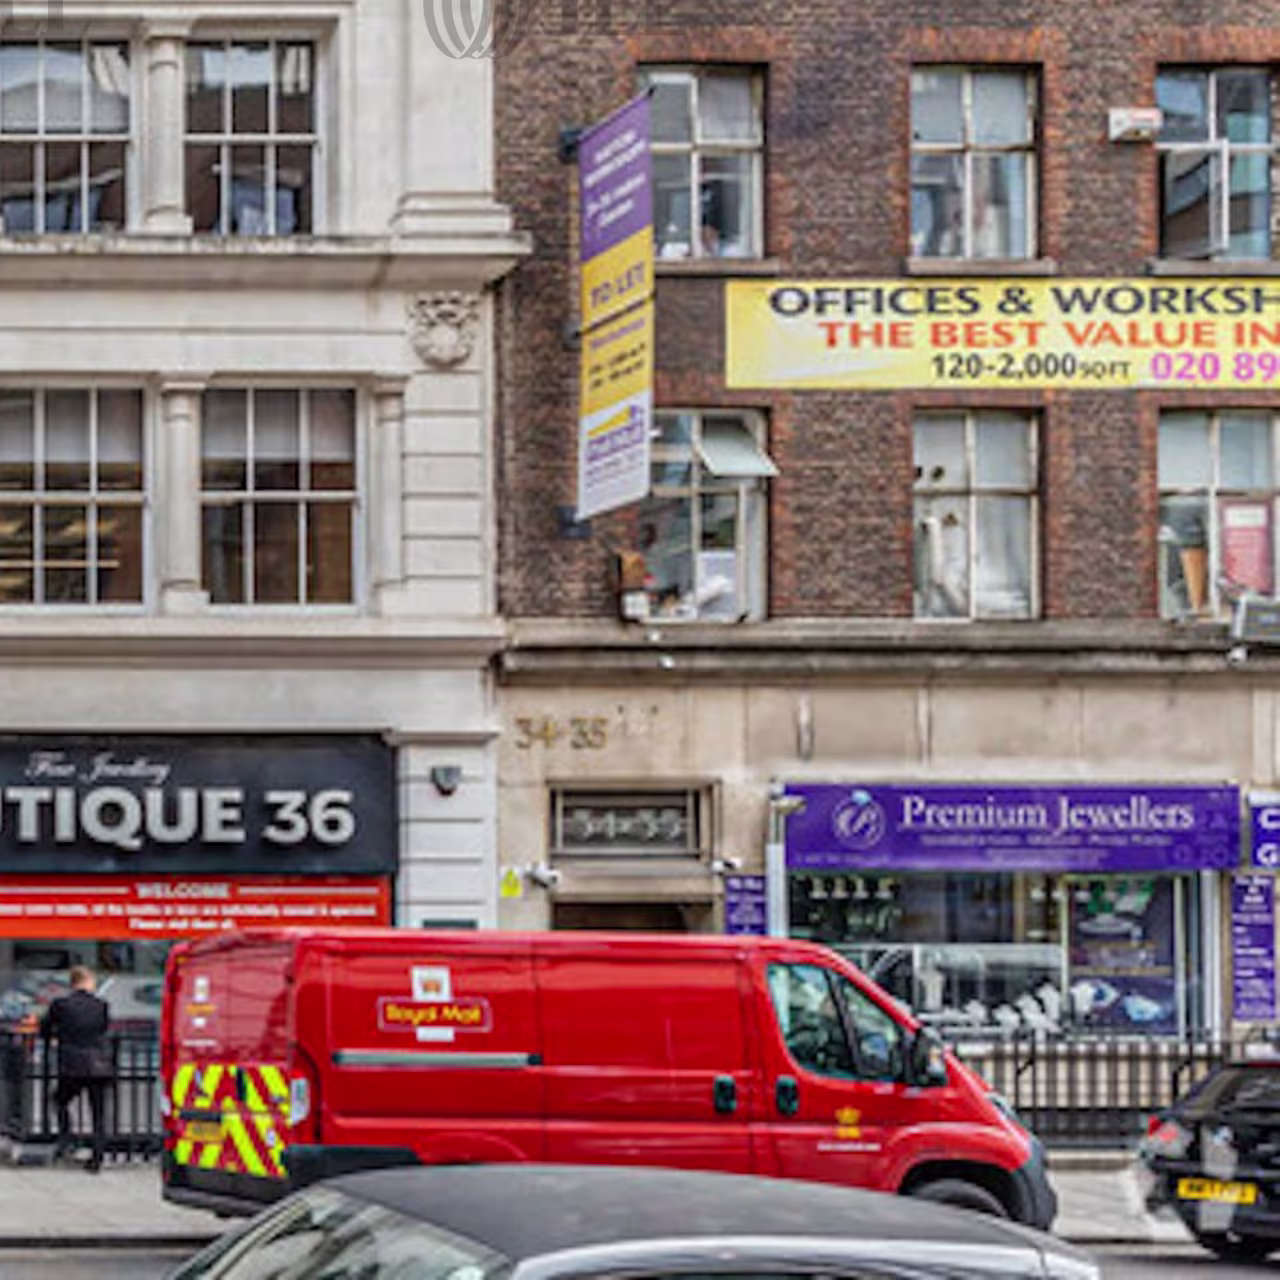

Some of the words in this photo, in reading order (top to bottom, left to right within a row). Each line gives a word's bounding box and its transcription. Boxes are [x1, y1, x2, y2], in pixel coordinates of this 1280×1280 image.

[769, 287, 981, 316] OFFICES
[997, 287, 1033, 315] &
[819, 322, 915, 348] THE
[930, 322, 1046, 348] BEST
[1062, 322, 1217, 348] VALUE
[1233, 322, 1280, 348] IN
[1151, 353, 1221, 381] 020
[262, 789, 356, 844] 36
[902, 794, 1048, 828] Premium
[1050, 794, 1194, 836] Jewellers
[135, 882, 229, 899] WELCOME
[385, 1004, 437, 1026] Royal
[441, 1005, 481, 1024] Mail
